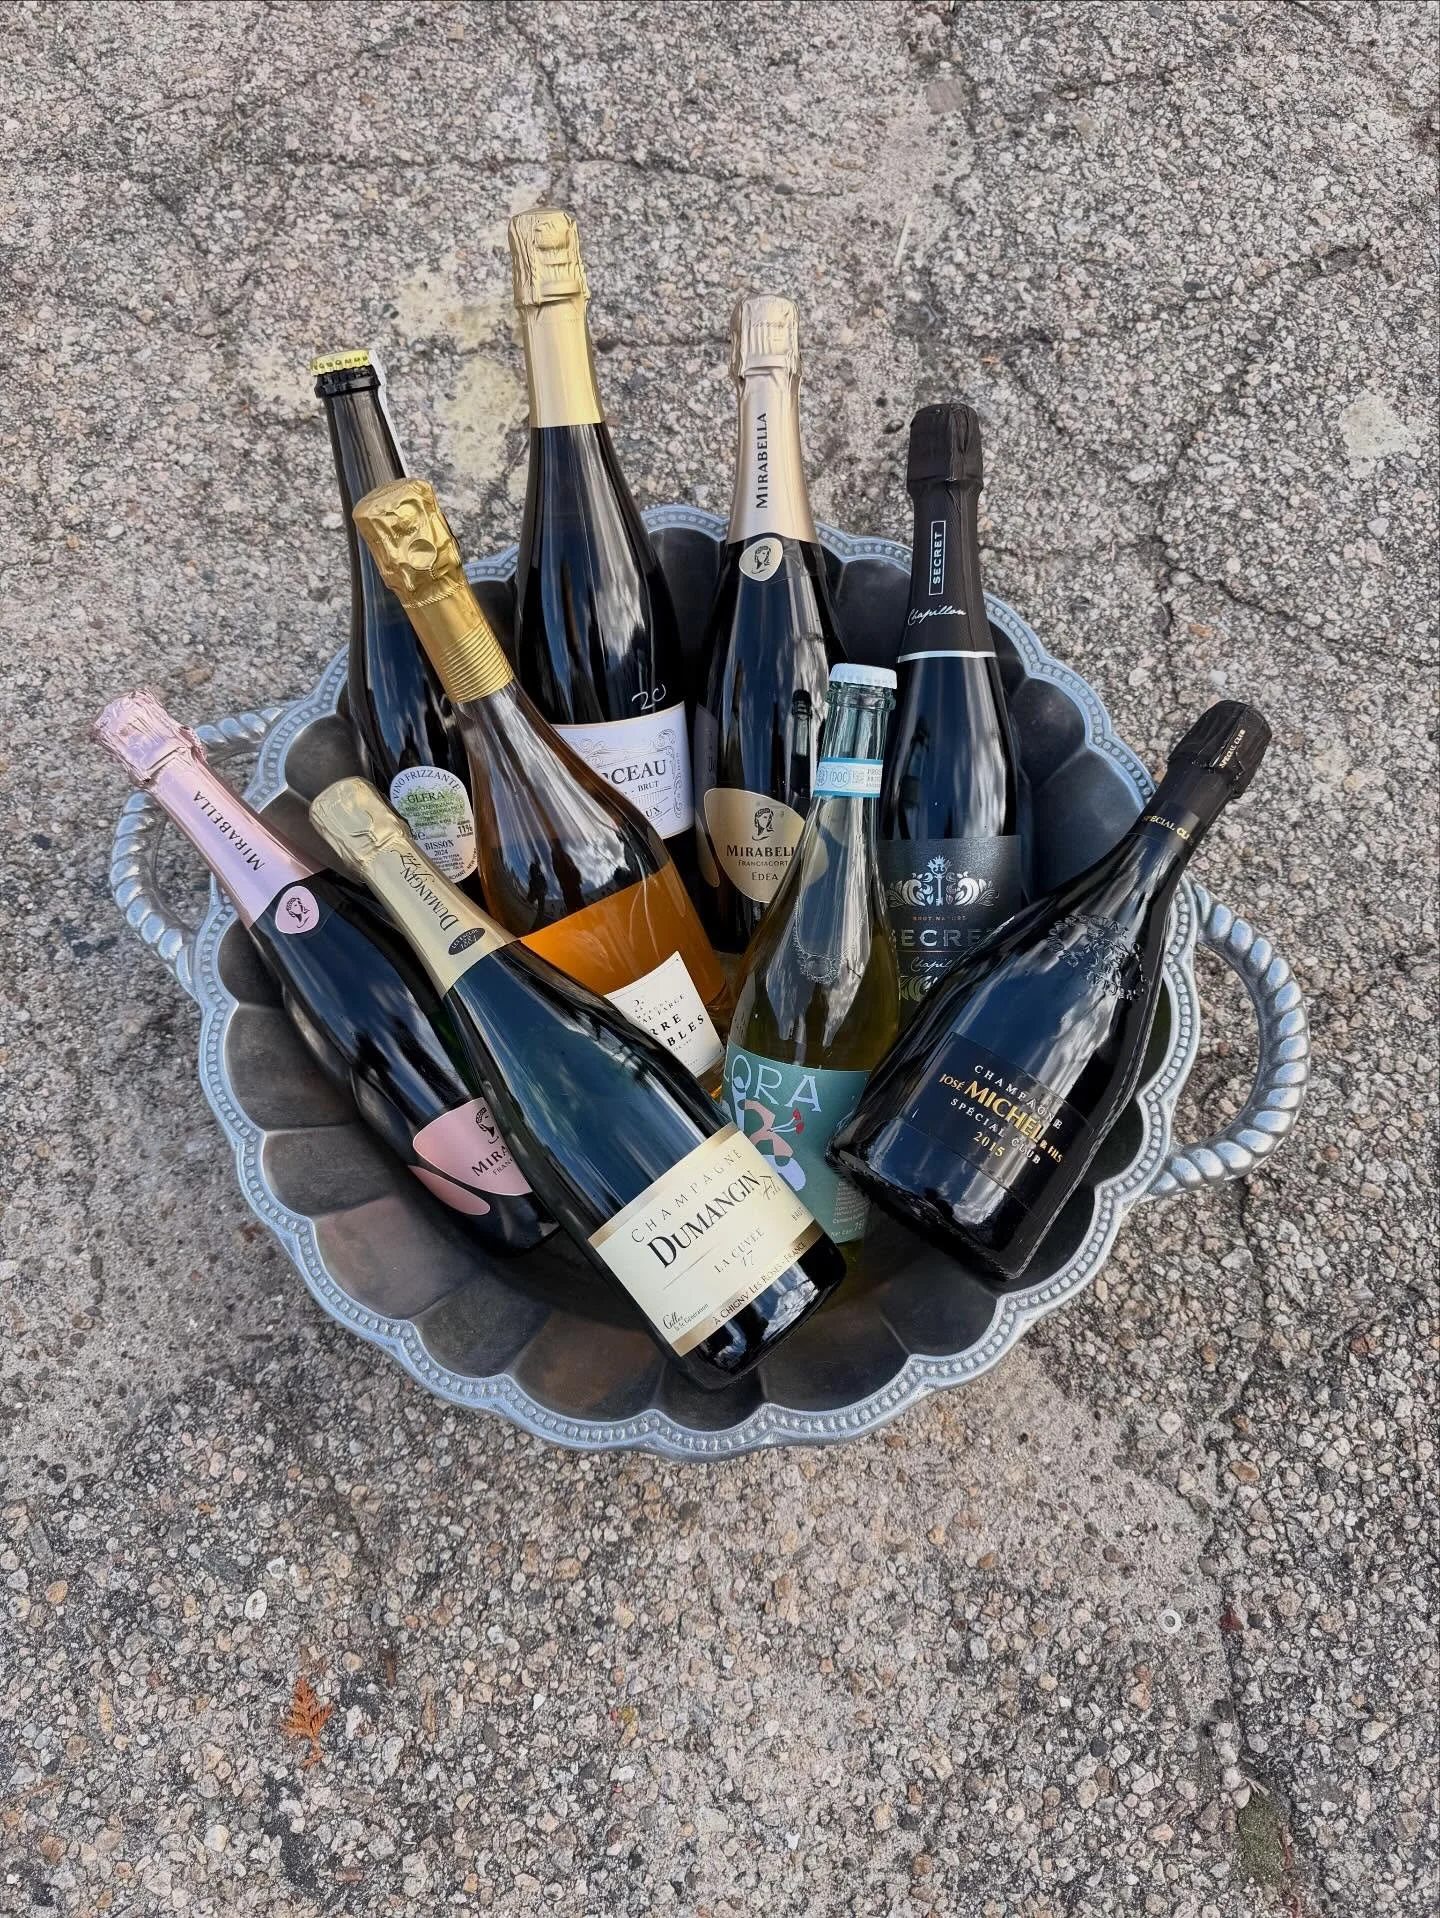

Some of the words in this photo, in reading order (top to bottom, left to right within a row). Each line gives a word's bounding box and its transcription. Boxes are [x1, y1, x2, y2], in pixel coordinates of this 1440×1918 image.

[755, 412, 769, 508] MIRABELLA
[933, 532, 942, 584] SECRET
[632, 684, 666, 710] 20
[1234, 729, 1247, 744] CLUB
[393, 777, 405, 800] VINO
[405, 769, 461, 792] FRIZZANTE
[407, 791, 445, 804] GLERA
[638, 781, 660, 792] BRUT
[193, 790, 265, 871] MIRABELLA
[457, 824, 473, 834] 11%
[1143, 815, 1176, 831] SPECIAL
[424, 840, 454, 850] BISSON
[751, 872, 779, 881] EDEA
[400, 867, 459, 931] DUMANGIN
[666, 1014, 704, 1047] BLES
[974, 1065, 1063, 1130] CHAMPAGNE
[939, 1073, 966, 1091] JOSÉ
[964, 1080, 1044, 1143] MICHEL
[1040, 1140, 1048, 1149] &
[1047, 1145, 1064, 1163] FILS
[950, 1098, 1007, 1138] SPÉCIAL
[1011, 1137, 1041, 1164] CLUB
[973, 1131, 1006, 1157] 2015
[631, 1149, 743, 1243] CHAMPAGNE
[646, 1169, 761, 1268] DUMANGIN
[713, 1259, 730, 1273] LA
[720, 1291, 750, 1318] CHIGNY
[749, 1282, 762, 1294] LES
[784, 1242, 806, 1263] FRANCE
